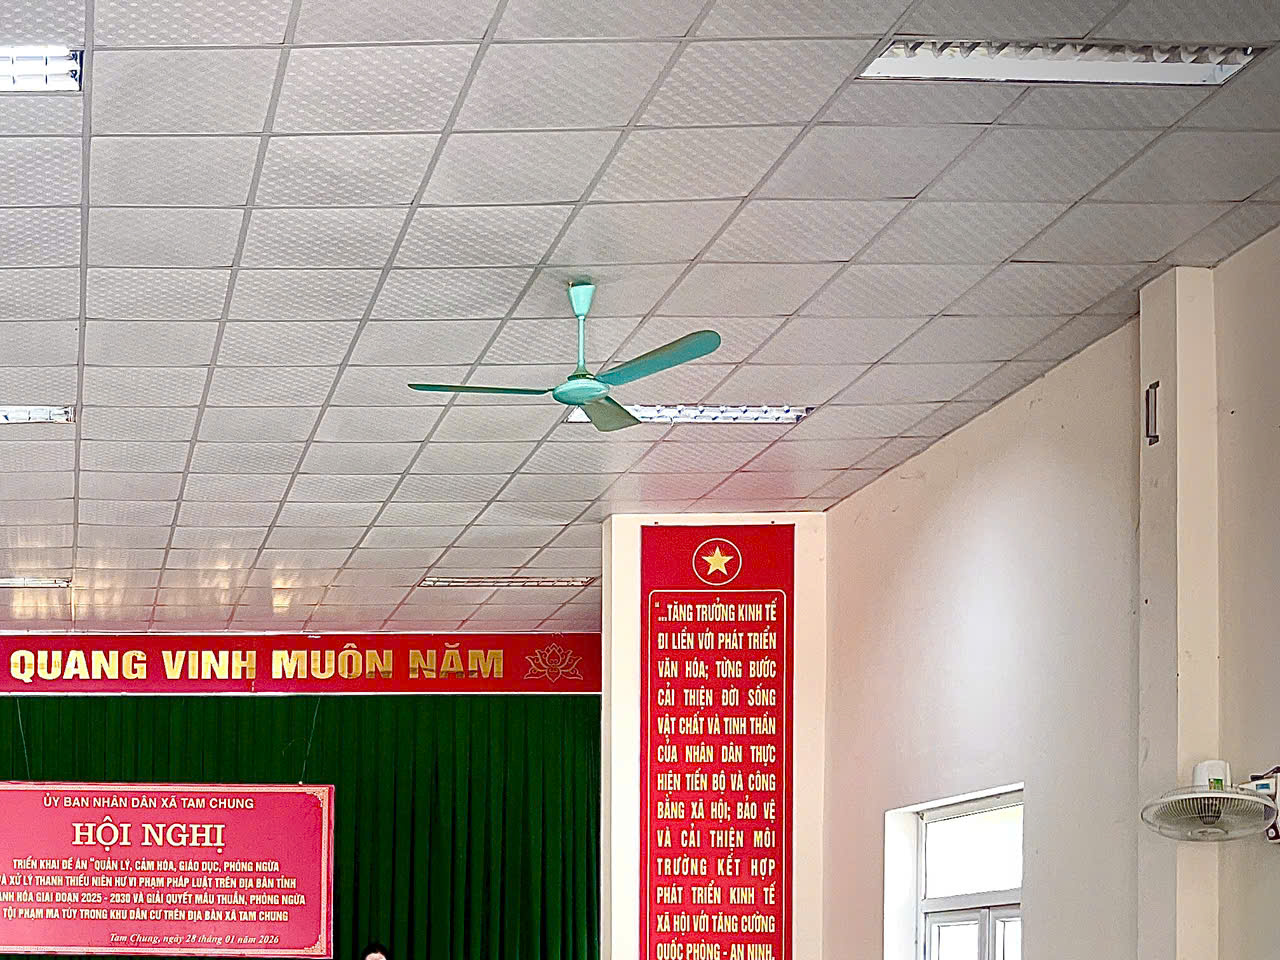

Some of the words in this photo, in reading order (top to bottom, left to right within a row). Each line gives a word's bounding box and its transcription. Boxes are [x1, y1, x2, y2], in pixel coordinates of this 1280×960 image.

[696, 597, 735, 621] TRƯỞNG
[738, 604, 762, 621] KINH
[765, 597, 777, 621] TẾ
[657, 632, 668, 649] ĐI
[672, 626, 694, 649] LIỀN
[698, 627, 714, 650] VỚI
[718, 629, 744, 650] PHÁT
[747, 625, 776, 649] TRIỂN
[10, 649, 148, 682] QUANG
[162, 650, 257, 679] VINH
[272, 643, 393, 679] MUÔN
[408, 642, 504, 679] NĂM
[658, 657, 678, 678] VĂN
[685, 657, 708, 680] HÓA;
[715, 656, 742, 678] TỪNG
[749, 656, 776, 678] BƯỚC
[658, 682, 675, 706] CẢI
[683, 685, 713, 710] THIỆN
[721, 684, 739, 706] ĐỜI
[748, 683, 776, 706] SỐNG
[657, 713, 676, 738] VẬT
[679, 711, 705, 735] CHẤT
[707, 713, 720, 735] VÀ
[723, 717, 747, 735] TINH
[749, 711, 776, 735] THẦN
[657, 738, 678, 763] CỦA
[685, 741, 714, 763] NHÂN
[721, 741, 742, 763] DÂN
[750, 744, 776, 767] THỰC
[657, 770, 681, 795] HIỆN
[685, 768, 708, 791] TIẾN
[712, 770, 726, 795] BỘ
[730, 770, 744, 791] VÀ
[748, 770, 776, 791] CÔNG
[44, 793, 60, 807] ỦY
[64, 797, 89, 807] BAN
[93, 795, 127, 807] NHÂN
[131, 795, 157, 808] DÂN
[161, 795, 177, 808] XÃ
[180, 798, 205, 808] TAM
[209, 798, 254, 809] CHUNG
[657, 794, 685, 819] BẰNG
[691, 798, 705, 819] XÃ
[711, 799, 731, 823] HỘI;
[737, 795, 757, 819] BẢO
[763, 798, 775, 823] VỆ
[72, 816, 131, 851] HỘI
[141, 824, 225, 853] NGHỊ
[657, 826, 671, 847] VÀ
[681, 823, 700, 847] CẢI
[709, 827, 744, 851] THIỆN
[753, 827, 775, 848] MÔI
[40, 859, 60, 869] KHAI
[657, 853, 707, 876] TRƯỜNG
[717, 853, 741, 876] KẾT
[751, 857, 775, 880] HỢP
[35, 875, 63, 886] THANH
[128, 877, 137, 887] VI
[657, 883, 683, 904] PHÁT
[691, 880, 721, 904] TRIỂN
[730, 887, 754, 904] KINH
[763, 881, 776, 904] TẾ
[36, 892, 53, 902] GIAI
[81, 892, 102, 903] 2025
[110, 893, 131, 903] 2030
[46, 908, 60, 918] MA
[79, 909, 108, 919] TRONG
[110, 909, 127, 920] KHU
[239, 911, 256, 921] TAM
[259, 911, 288, 921] CHUNG
[657, 912, 671, 932] XÃ
[673, 911, 690, 936] HỘI
[692, 909, 709, 932] VỚI
[712, 912, 738, 933] TĂNG
[741, 911, 775, 933] CƯỜNG
[686, 939, 720, 960] PHÒNG
[730, 944, 744, 960] AN
[747, 944, 775, 960] NINH.
